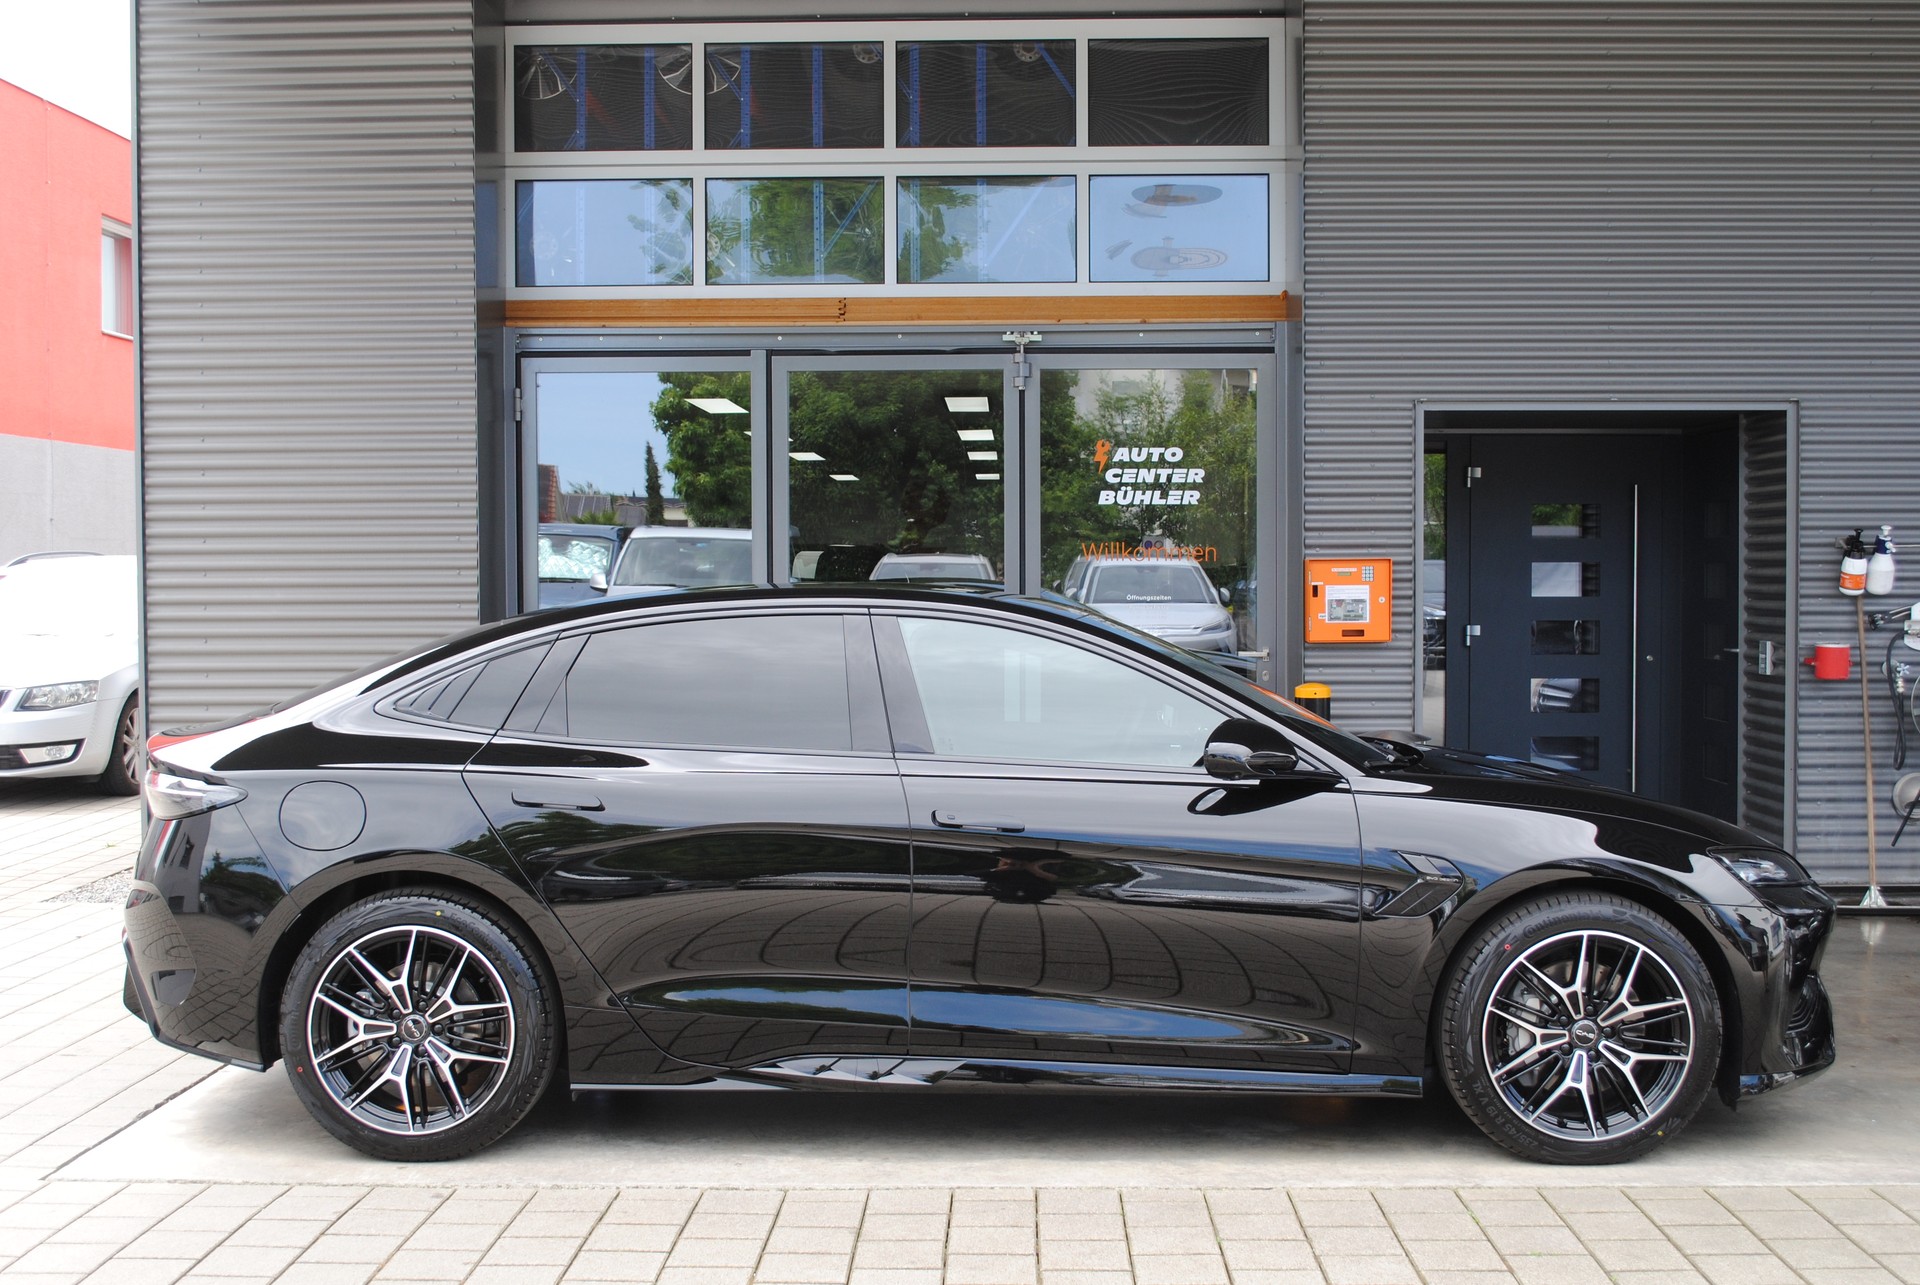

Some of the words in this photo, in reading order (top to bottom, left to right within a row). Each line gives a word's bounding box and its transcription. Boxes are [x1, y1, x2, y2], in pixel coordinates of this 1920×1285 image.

[1112, 447, 1184, 463] AUTO
[1104, 468, 1206, 484] CENTER
[1098, 486, 1201, 506] BÜHLER
[1081, 542, 1217, 562] Willkommen
[1126, 594, 1172, 602] Öffnungszeiten
[1522, 909, 1602, 939] Continental
